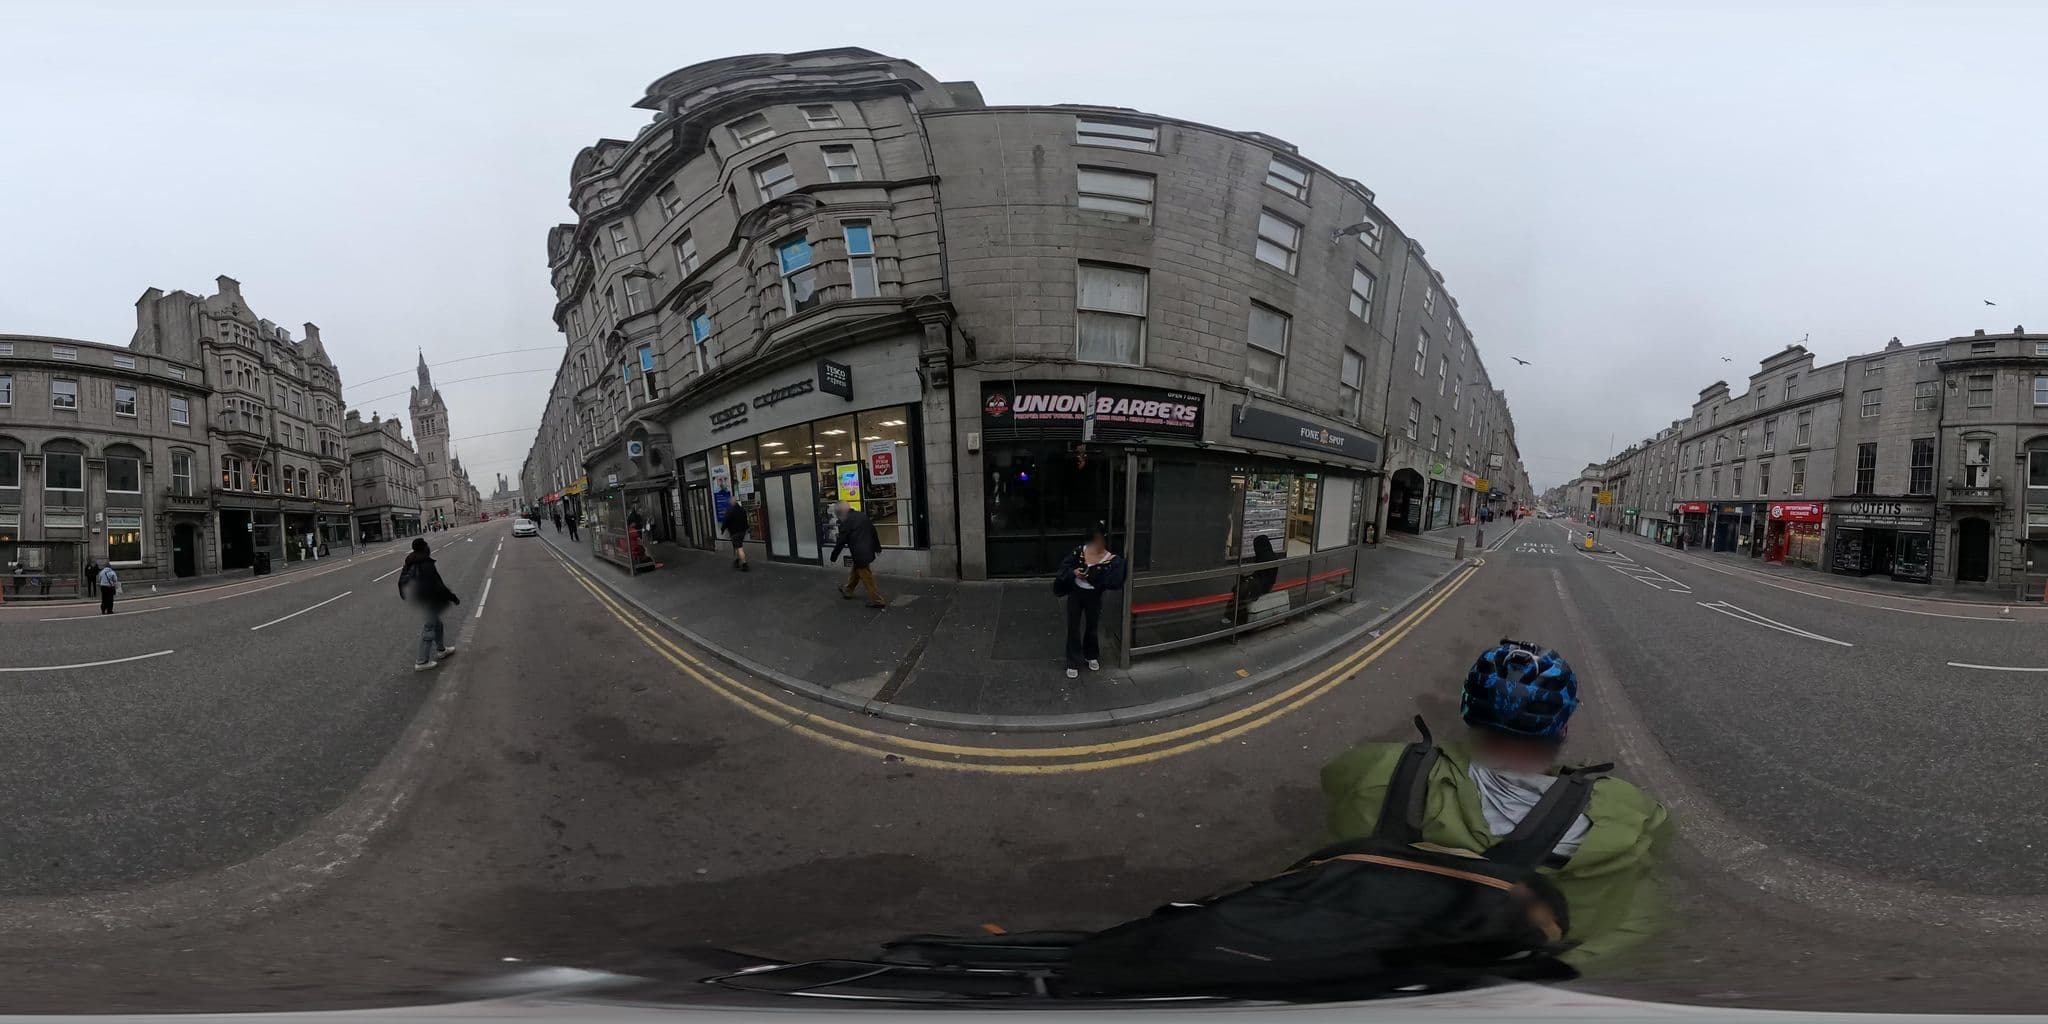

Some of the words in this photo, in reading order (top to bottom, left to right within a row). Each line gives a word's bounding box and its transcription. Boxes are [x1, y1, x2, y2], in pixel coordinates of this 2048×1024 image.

[825, 365, 846, 377] TESCO
[709, 402, 748, 426] TESCO
[1012, 394, 1086, 412] UNION
[1096, 397, 1198, 421] BARBERS
[1301, 427, 1319, 440] FONE
[1328, 435, 1345, 446] SPOT
[1850, 501, 1901, 515] OUTFITS
